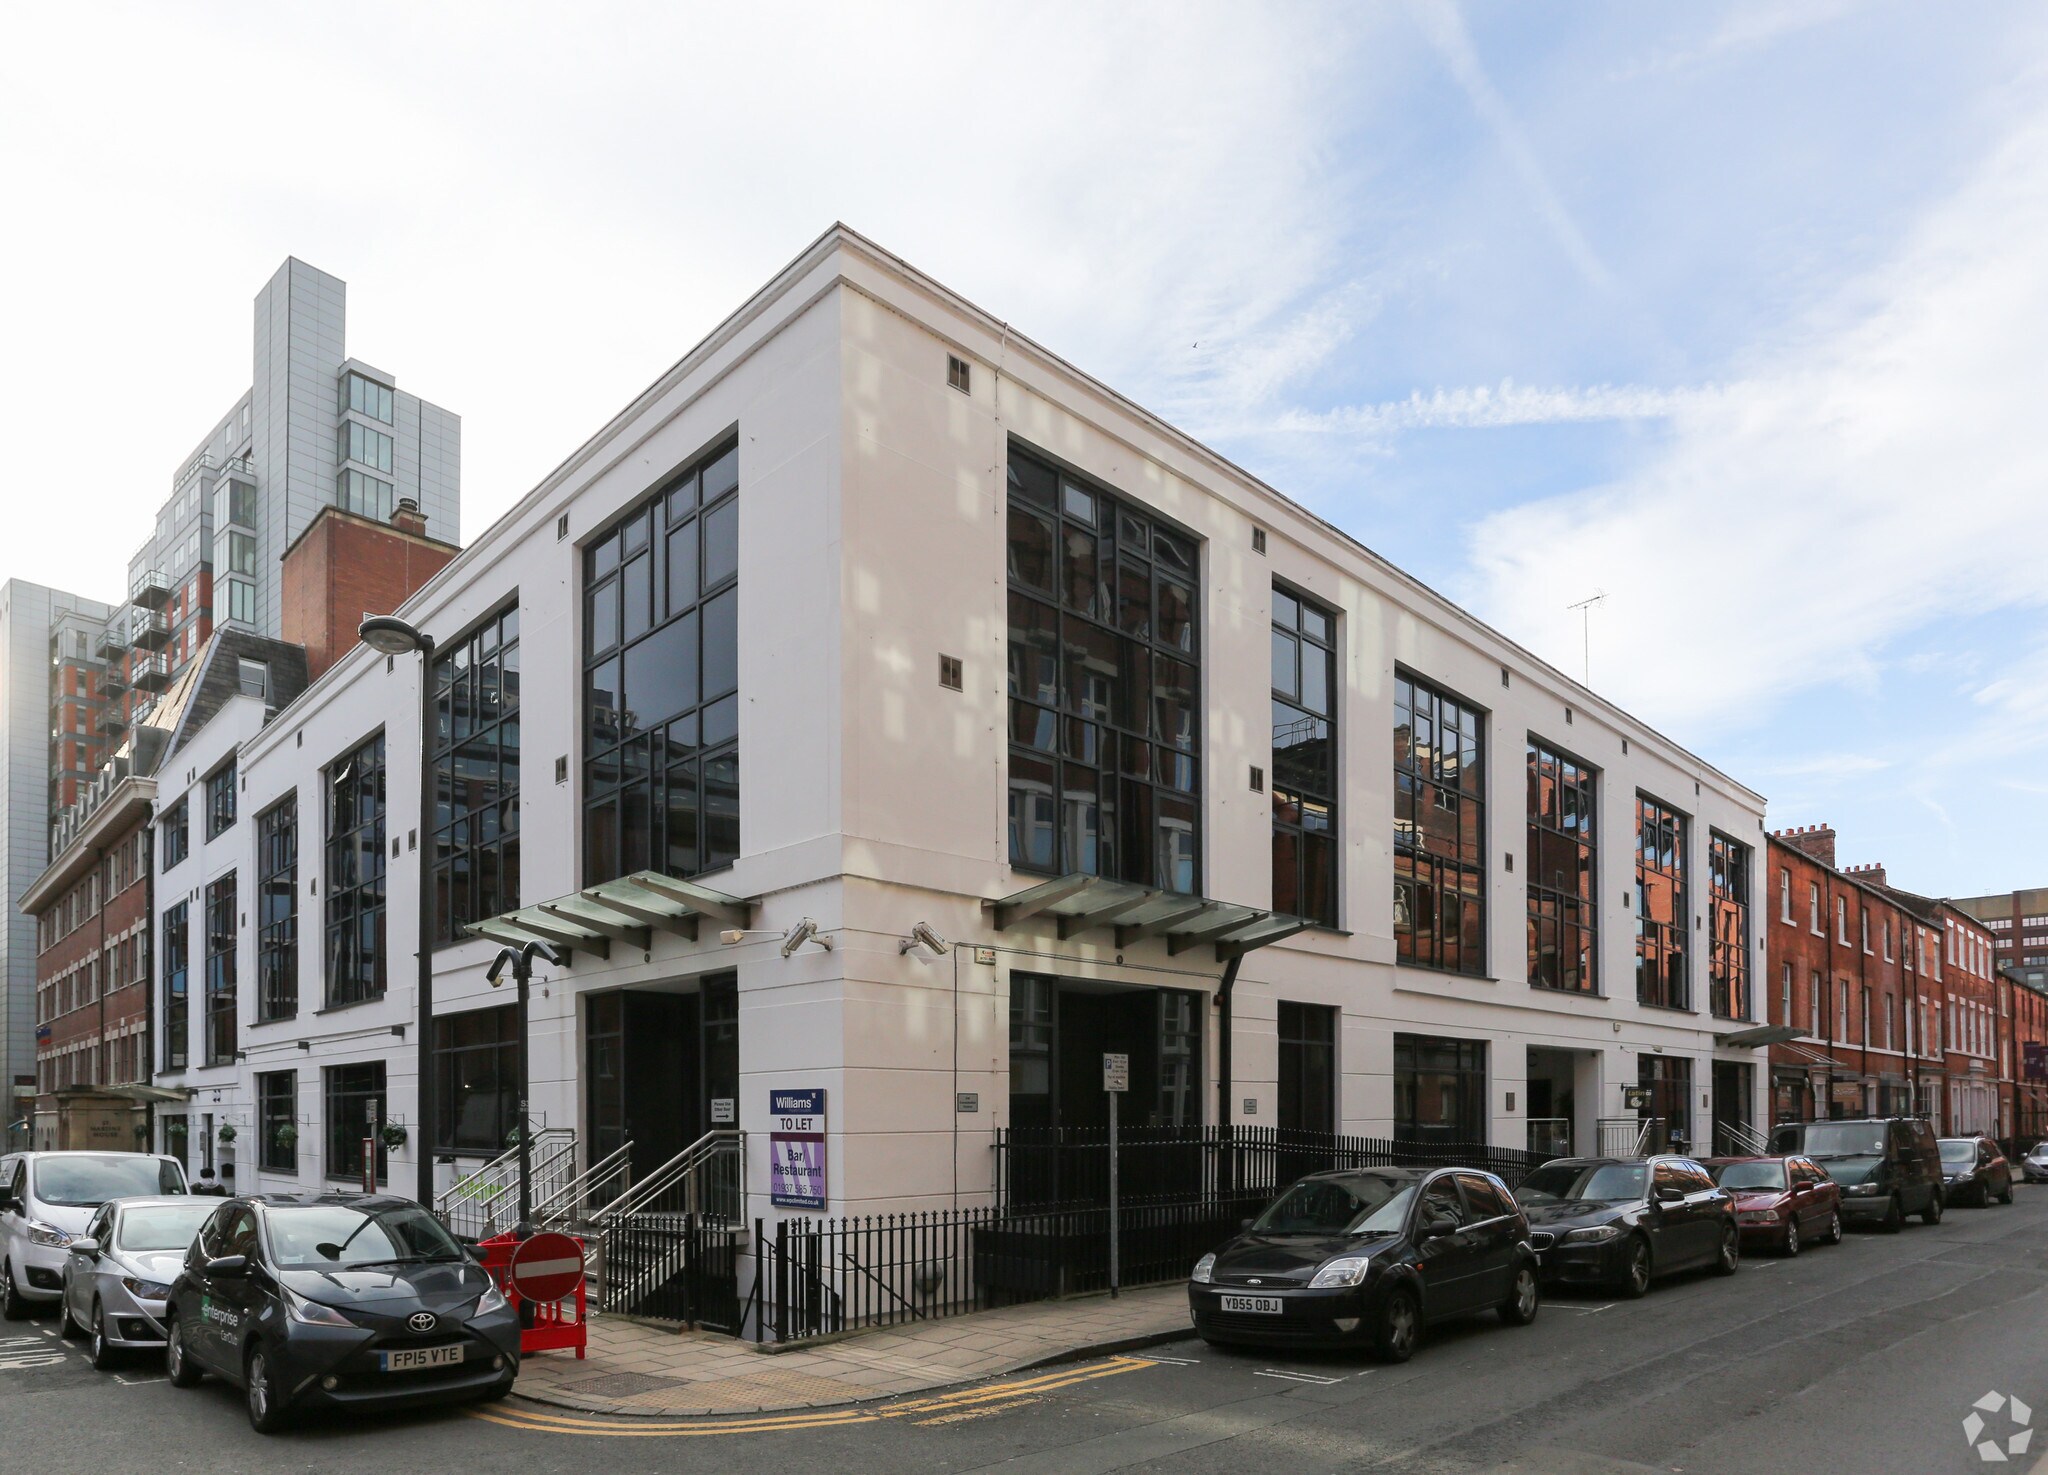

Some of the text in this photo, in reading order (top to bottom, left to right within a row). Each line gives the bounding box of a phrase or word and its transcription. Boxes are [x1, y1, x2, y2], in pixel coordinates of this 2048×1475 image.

[775, 1096, 812, 1109] Williams
[780, 1117, 813, 1131] TO LET
[787, 1149, 806, 1163] Bar/
[773, 1163, 822, 1178] Restaurant
[1225, 1297, 1278, 1312] YD55 OBJ
[204, 1303, 239, 1327] enterprise
[393, 1347, 458, 1368] FP15 VTE
